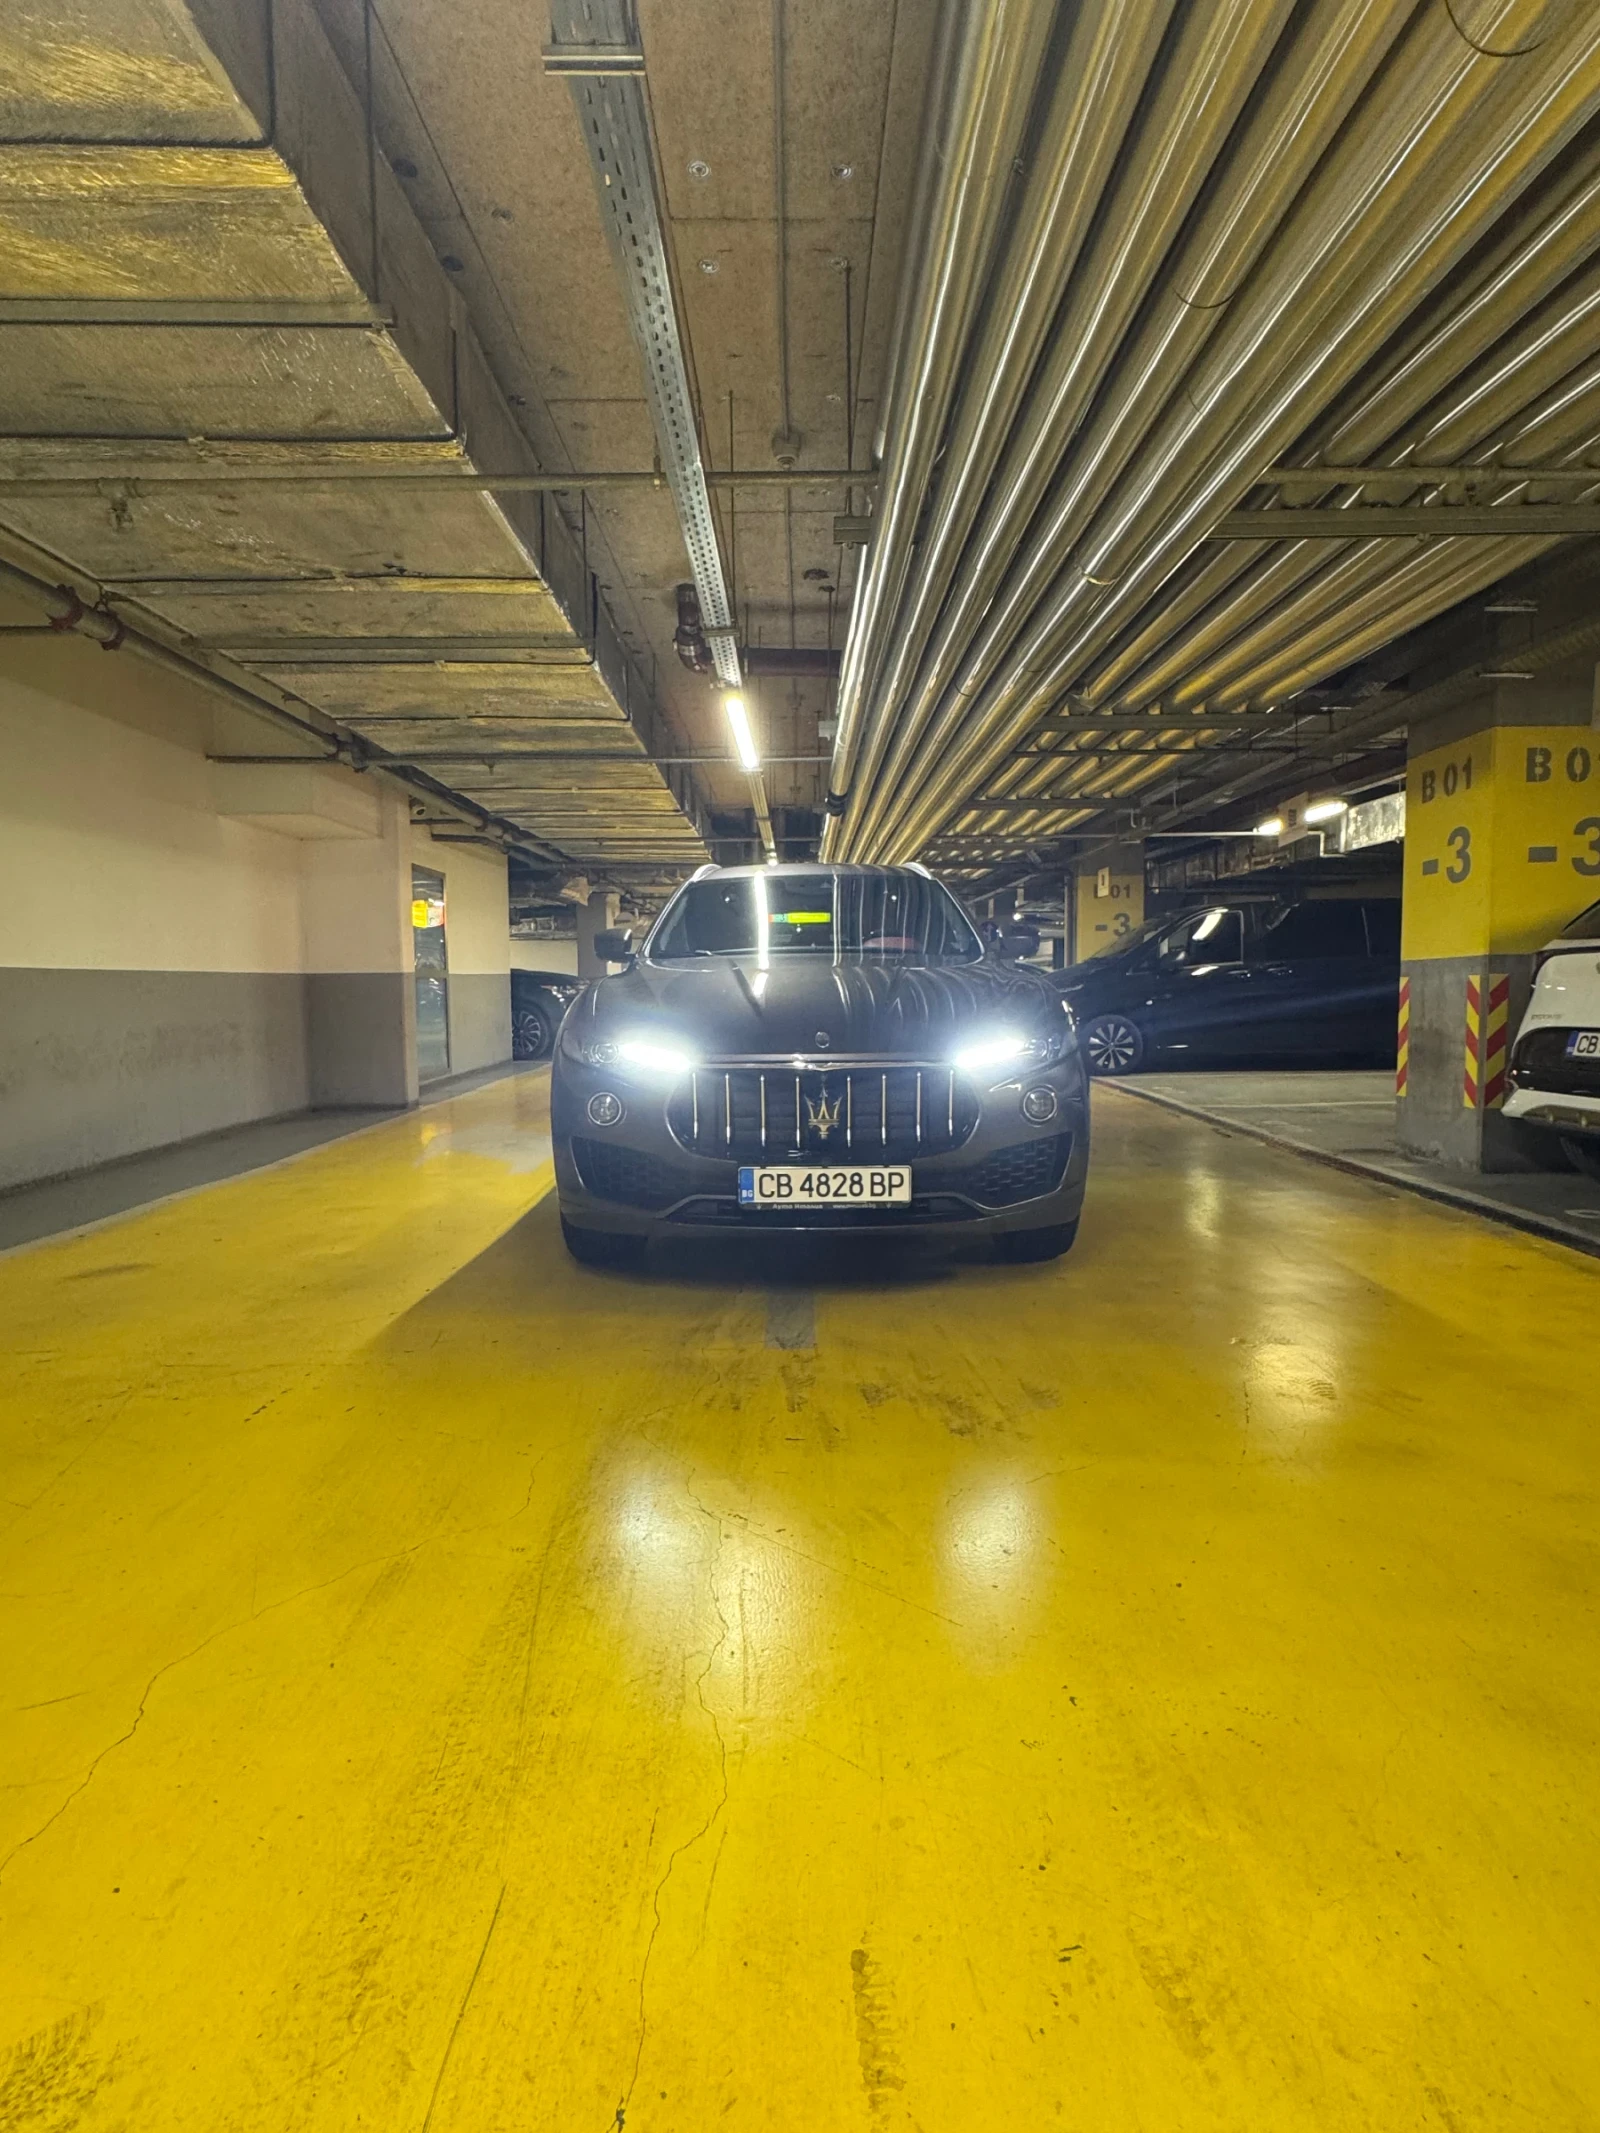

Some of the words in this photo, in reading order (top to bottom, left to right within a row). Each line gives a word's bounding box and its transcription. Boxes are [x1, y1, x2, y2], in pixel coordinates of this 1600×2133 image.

[1526, 747, 1600, 783] B0
[1422, 826, 1471, 884] -3
[759, 1173, 793, 1198] CB
[800, 1173, 864, 1198] 4828
[870, 1172, 904, 1197] BP
